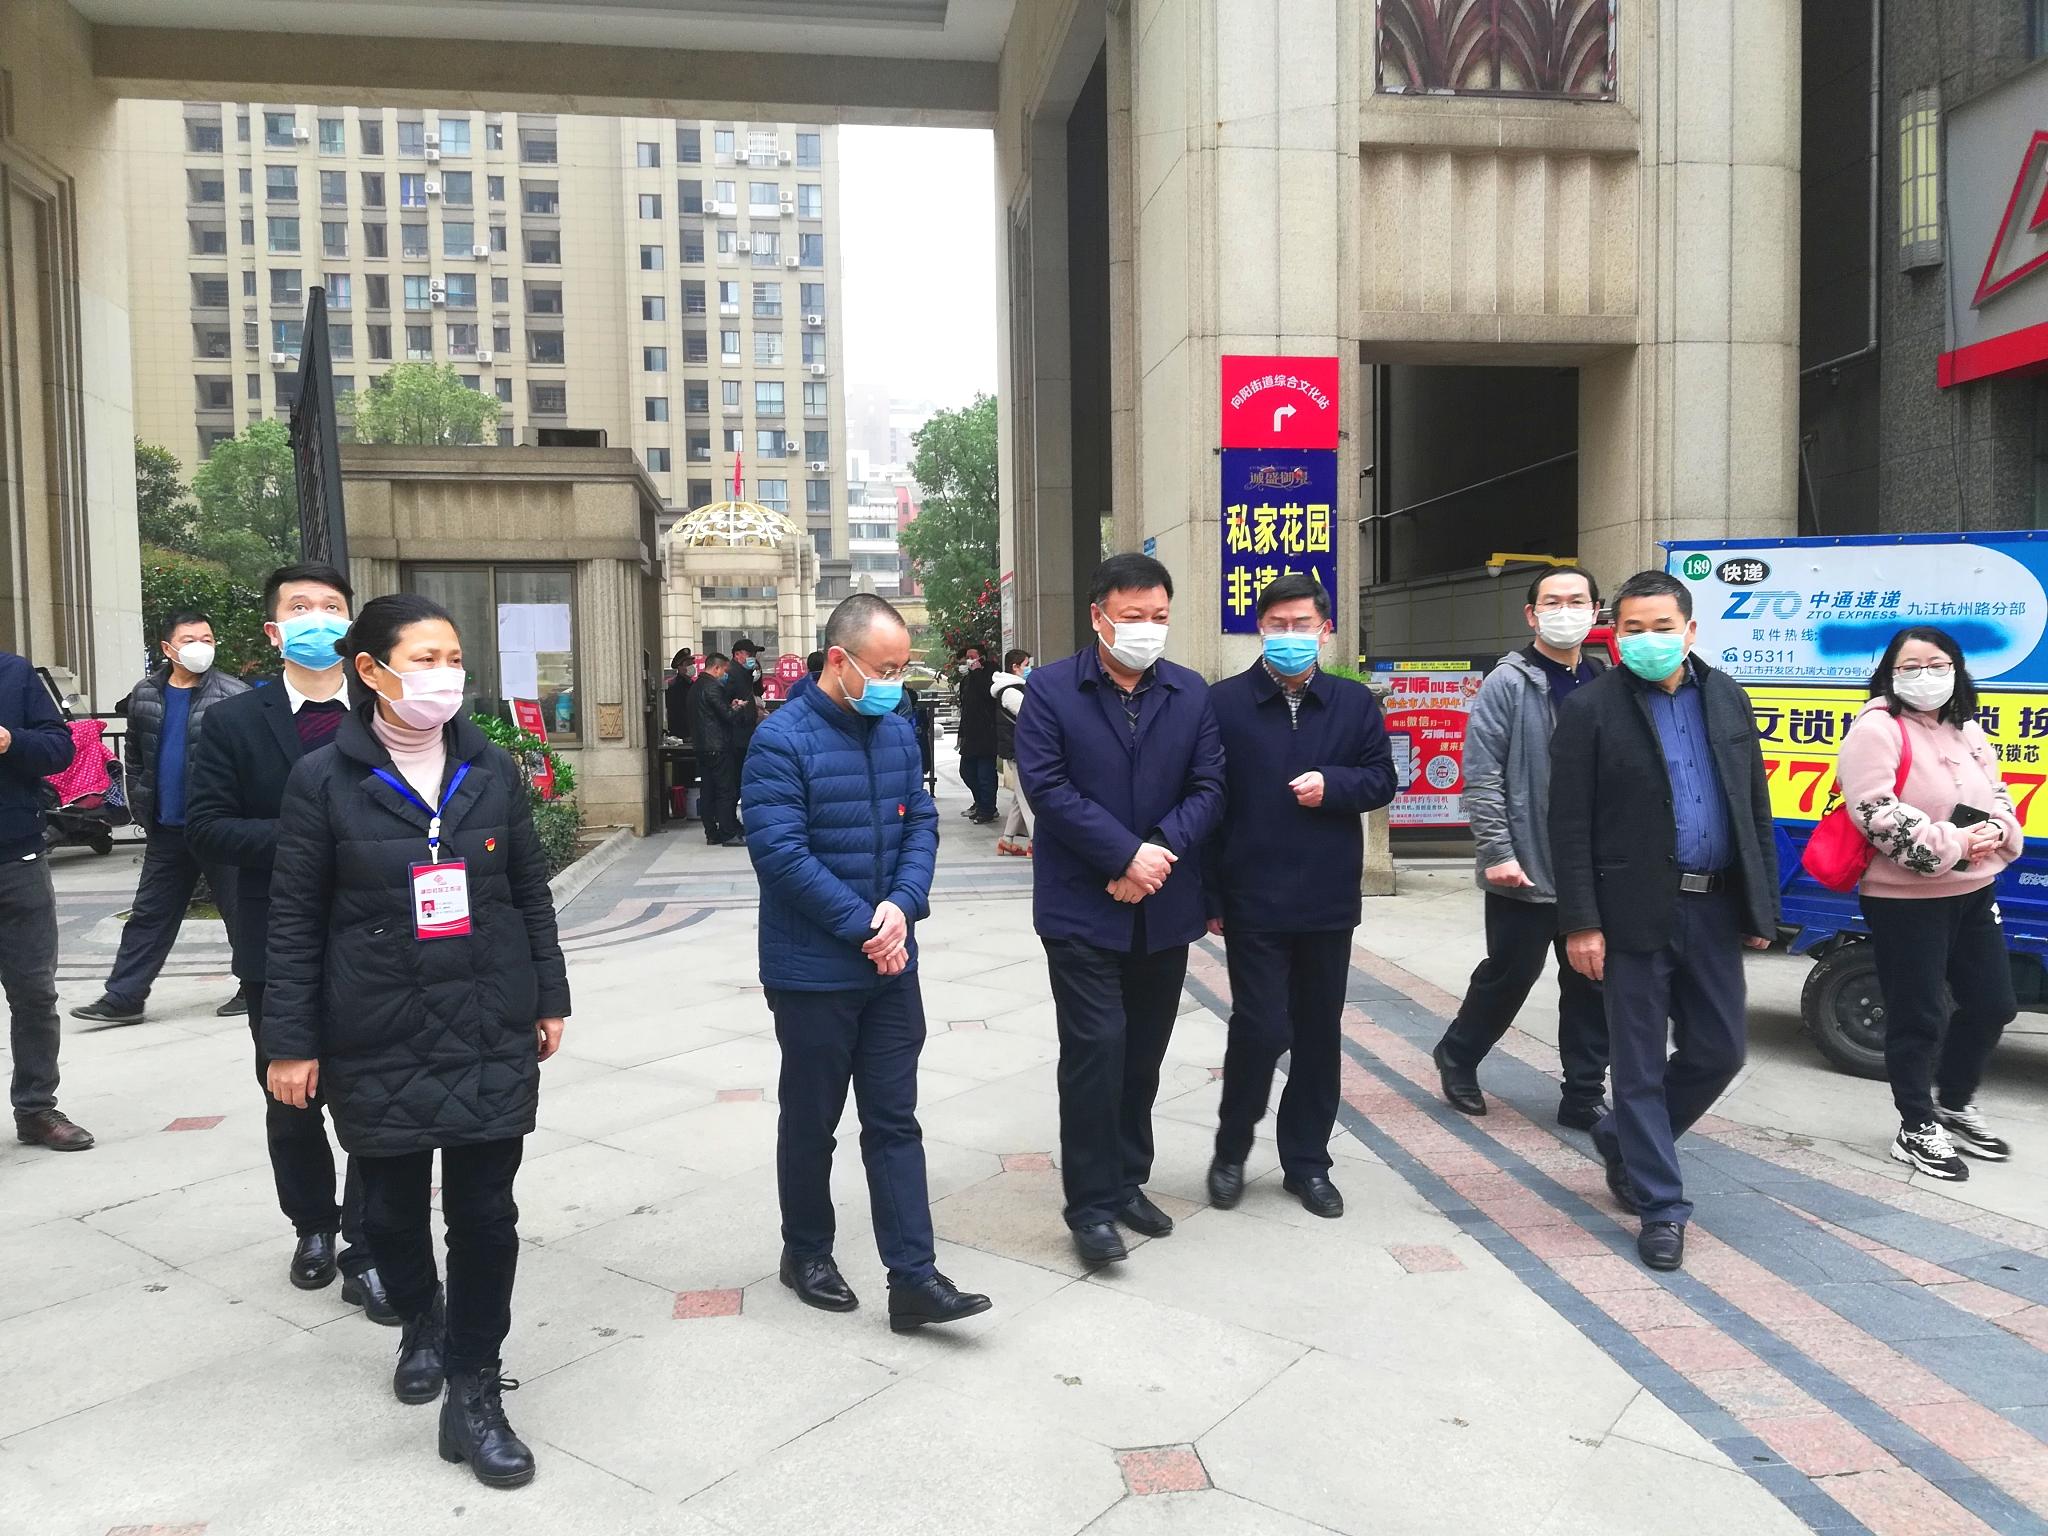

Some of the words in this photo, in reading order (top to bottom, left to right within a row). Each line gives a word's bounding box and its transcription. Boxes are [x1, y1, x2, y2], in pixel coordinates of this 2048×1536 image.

[1231, 374, 1330, 410] 向阳街道综合文化站
[1226, 502, 1330, 554] 私家花园
[1686, 559, 1710, 575] 189
[1722, 562, 1764, 582] 快递
[1227, 564, 1322, 616] 非请
[1810, 590, 1902, 609] 中通速递
[1720, 591, 1803, 620] ZTO
[1907, 601, 2026, 617] 九江杭州路分部
[1807, 611, 1832, 620] ZTO
[1838, 611, 1897, 620] EXPRESS
[1743, 650, 1794, 663] 95311
[1389, 676, 1461, 694] 万顺叫车
